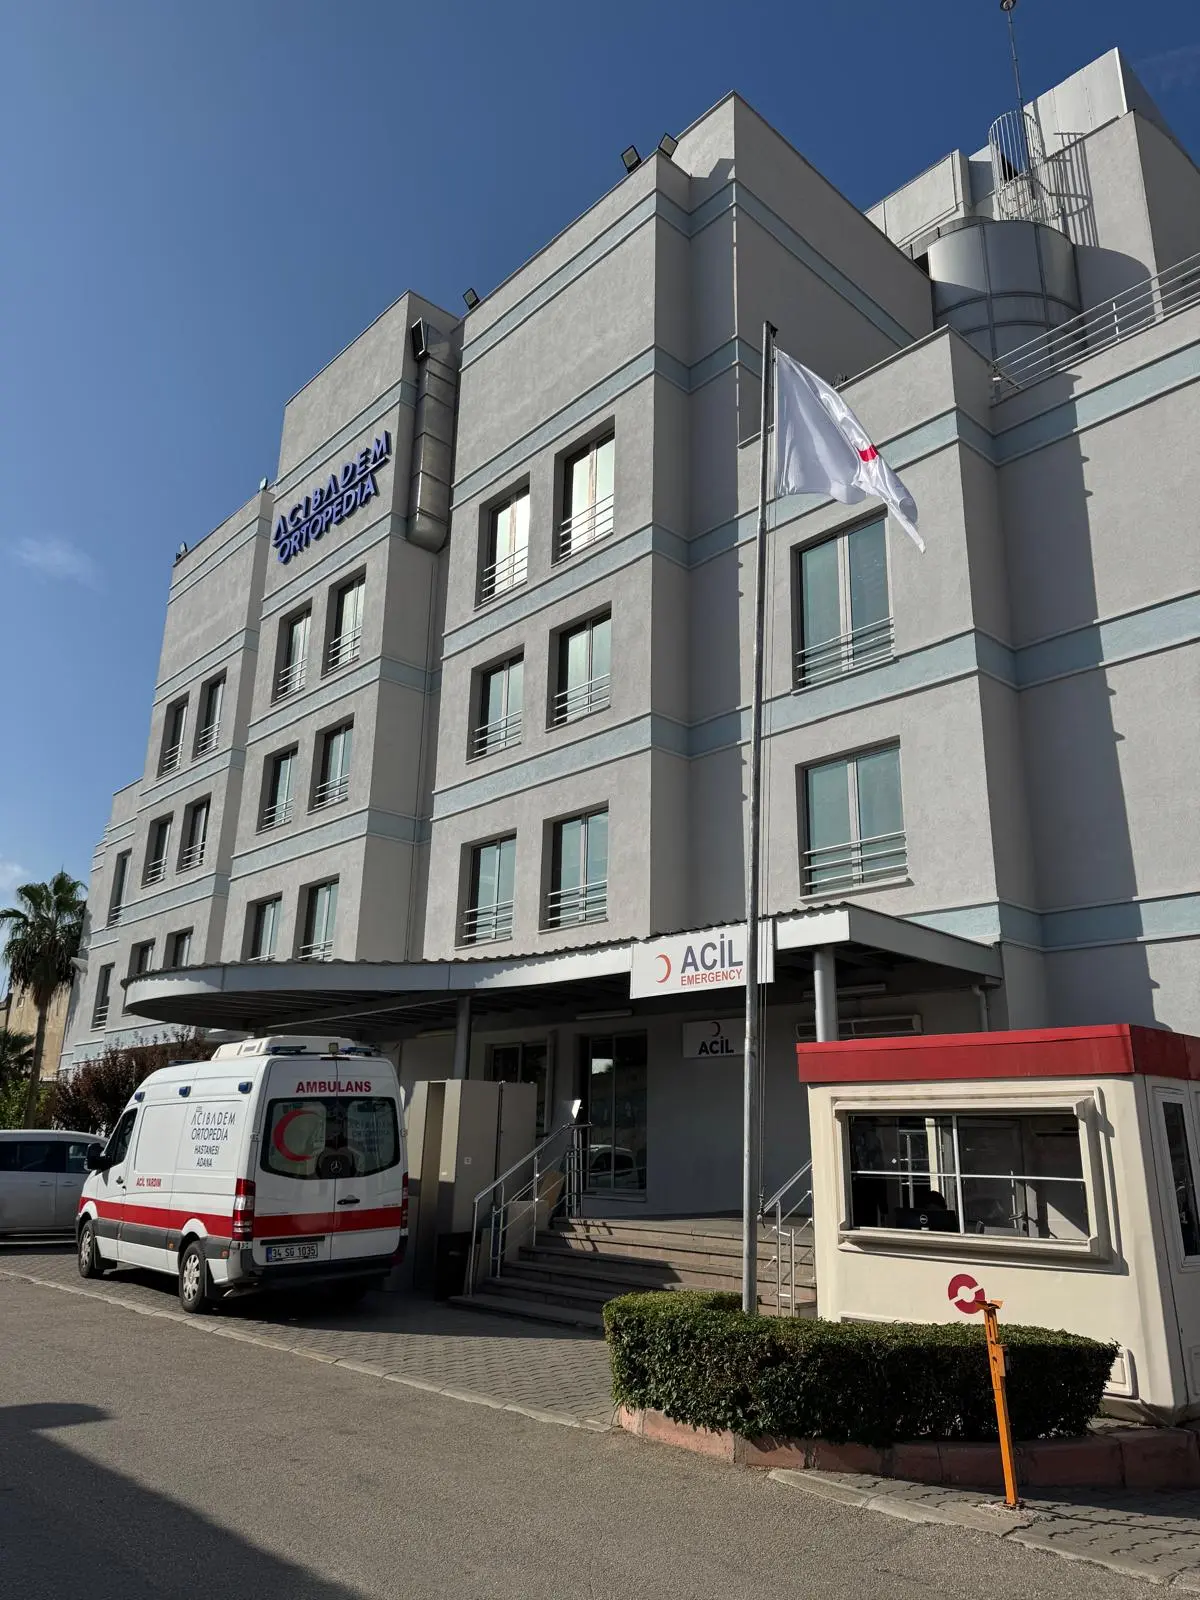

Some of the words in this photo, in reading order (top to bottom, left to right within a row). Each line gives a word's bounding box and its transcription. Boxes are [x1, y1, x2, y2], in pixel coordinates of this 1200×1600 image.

[273, 430, 391, 542] ACIBADEM
[278, 472, 379, 565] ORTOPEDIA
[680, 933, 743, 974] ACİL
[680, 968, 743, 986] EMERGENCY
[698, 1036, 734, 1056] ACİL
[295, 1081, 372, 1093] AMBULANS
[190, 1111, 236, 1126] ACIBADEM
[272, 1248, 281, 1258] 34
[297, 1245, 316, 1256] 1035
